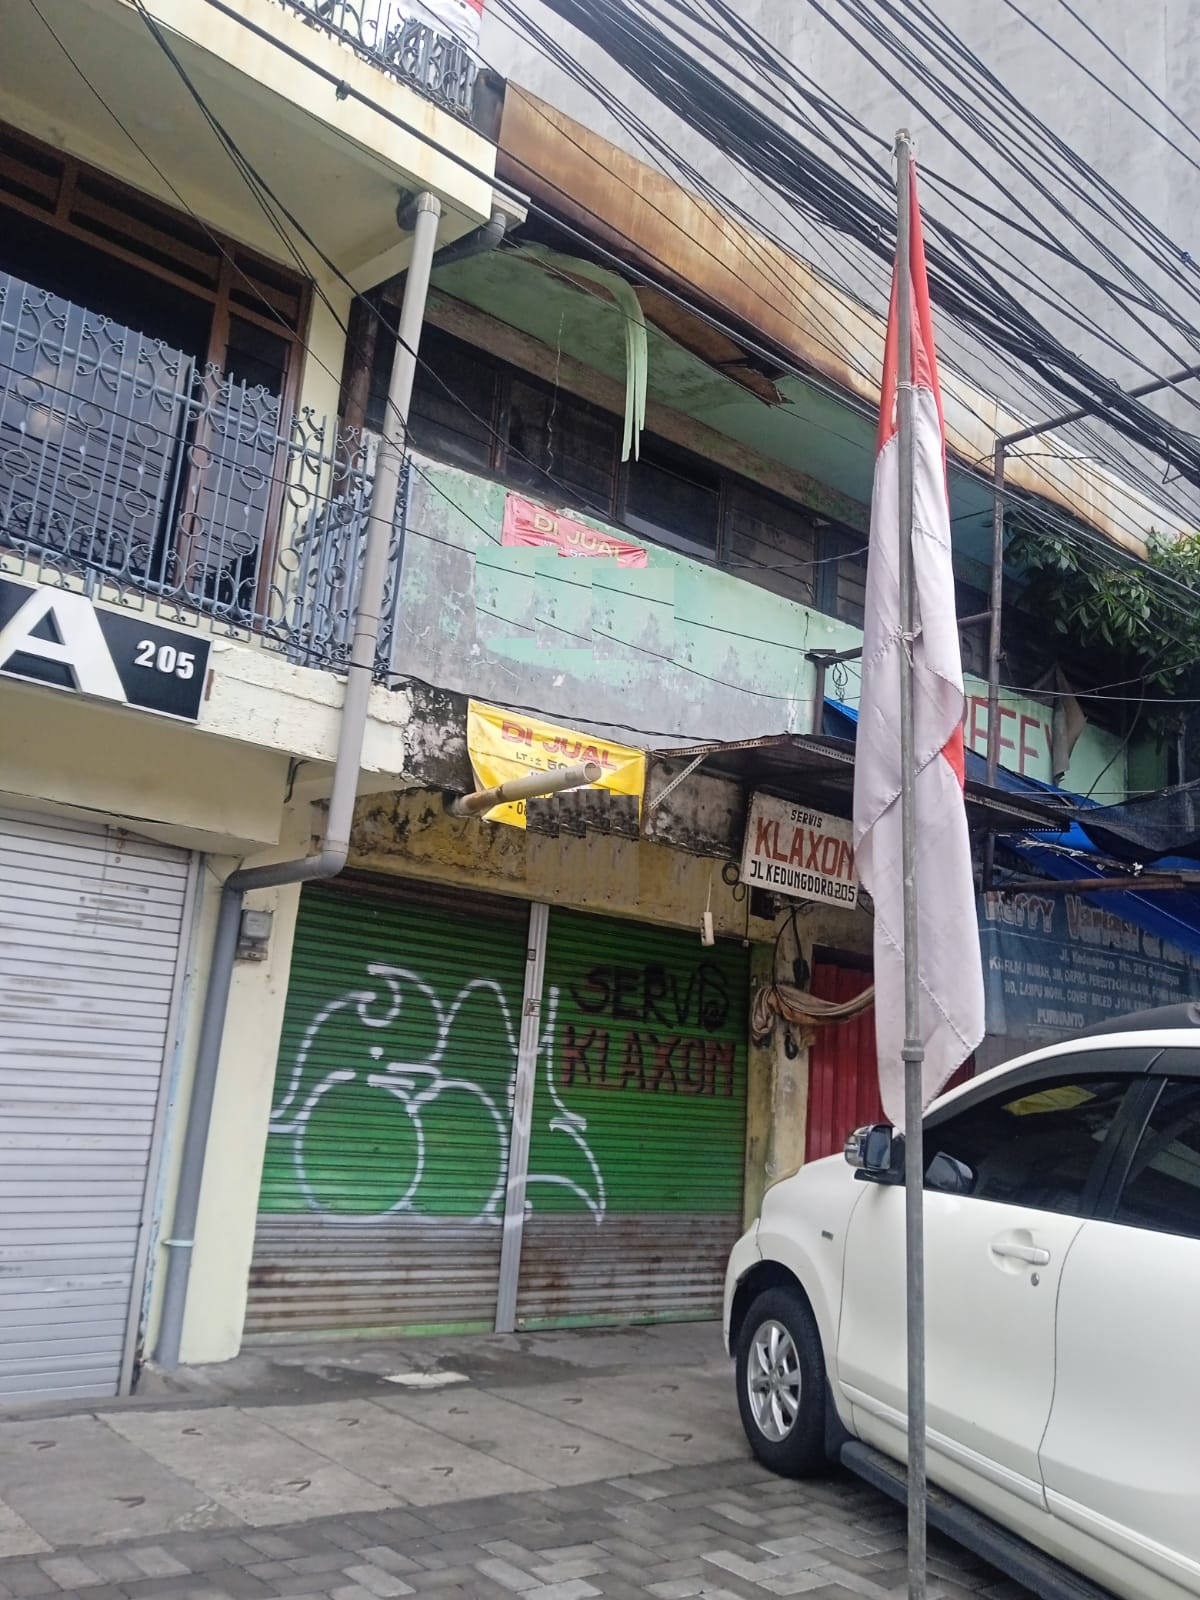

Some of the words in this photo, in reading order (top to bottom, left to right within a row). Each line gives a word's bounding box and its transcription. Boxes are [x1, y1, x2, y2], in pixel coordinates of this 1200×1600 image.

[533, 513, 560, 536] DI
[0, 586, 128, 704] A
[134, 639, 196, 681] 205
[501, 721, 534, 746] DI
[542, 736, 618, 771] JUAL
[790, 809, 823, 829] SERVIS
[754, 817, 855, 881] KLAXON
[560, 1024, 736, 1097] KLAXON
